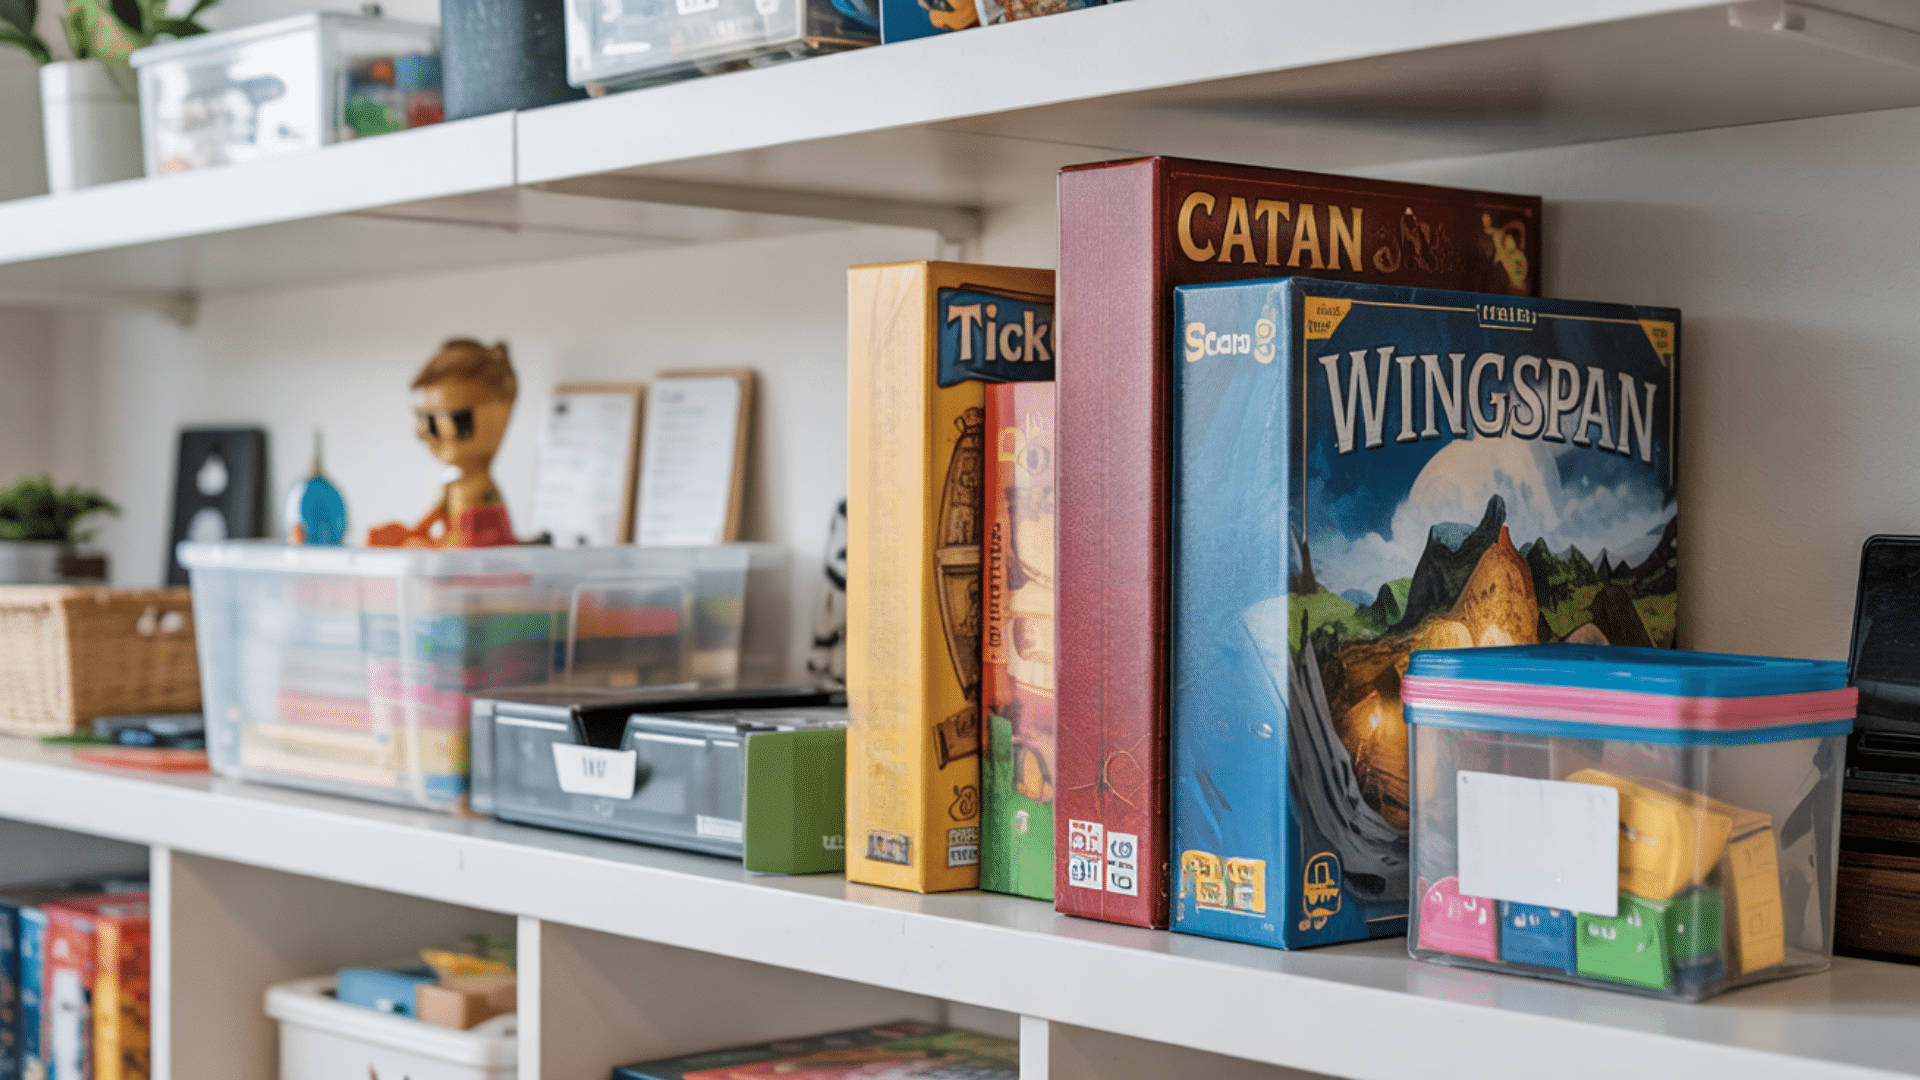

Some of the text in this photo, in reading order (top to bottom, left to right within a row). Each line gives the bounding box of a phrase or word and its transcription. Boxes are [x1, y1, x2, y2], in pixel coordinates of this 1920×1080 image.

[1177, 191, 1364, 272] CATAN
[947, 303, 1055, 362] Tick
[1318, 345, 1657, 464] WINGSPAN
